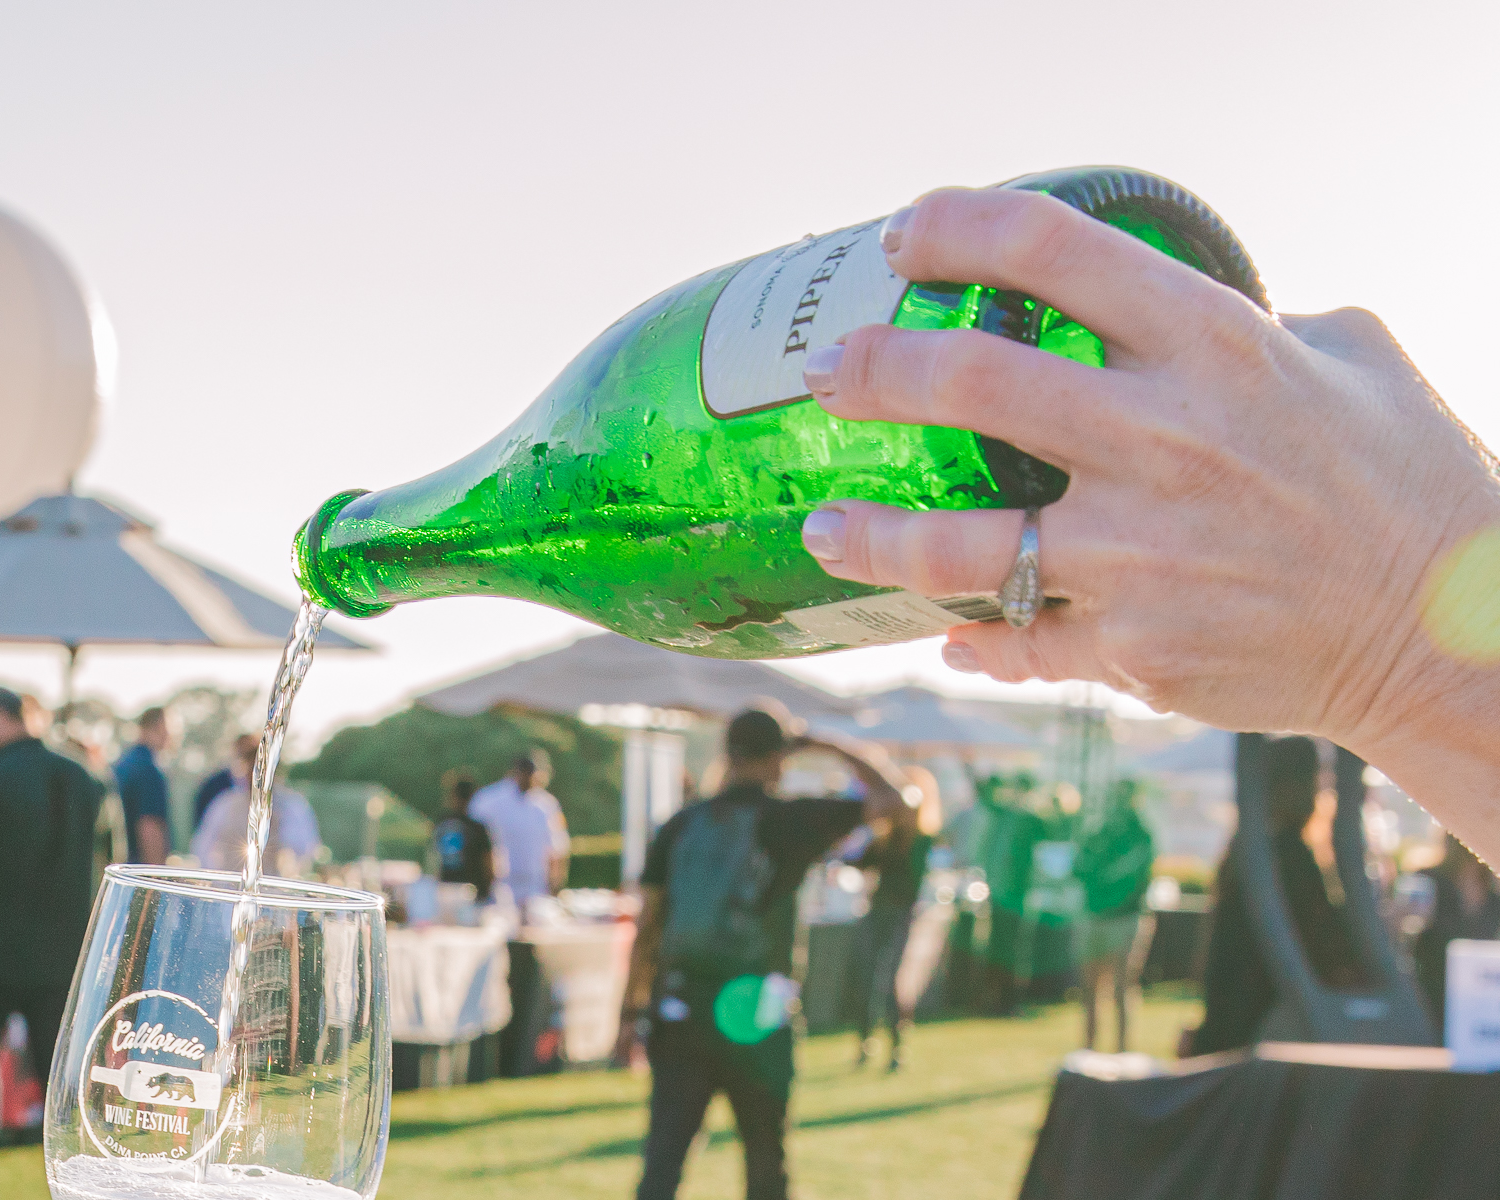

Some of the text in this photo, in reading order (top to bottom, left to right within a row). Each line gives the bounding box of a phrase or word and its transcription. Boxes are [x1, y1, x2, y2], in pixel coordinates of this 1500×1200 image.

[751, 265, 787, 329] SONOMA
[783, 238, 862, 358] PIPER
[111, 1019, 206, 1061] California
[105, 1104, 190, 1136] WINE FESTIVAL
[104, 1135, 132, 1159] DANA
[170, 1145, 188, 1159] CA
